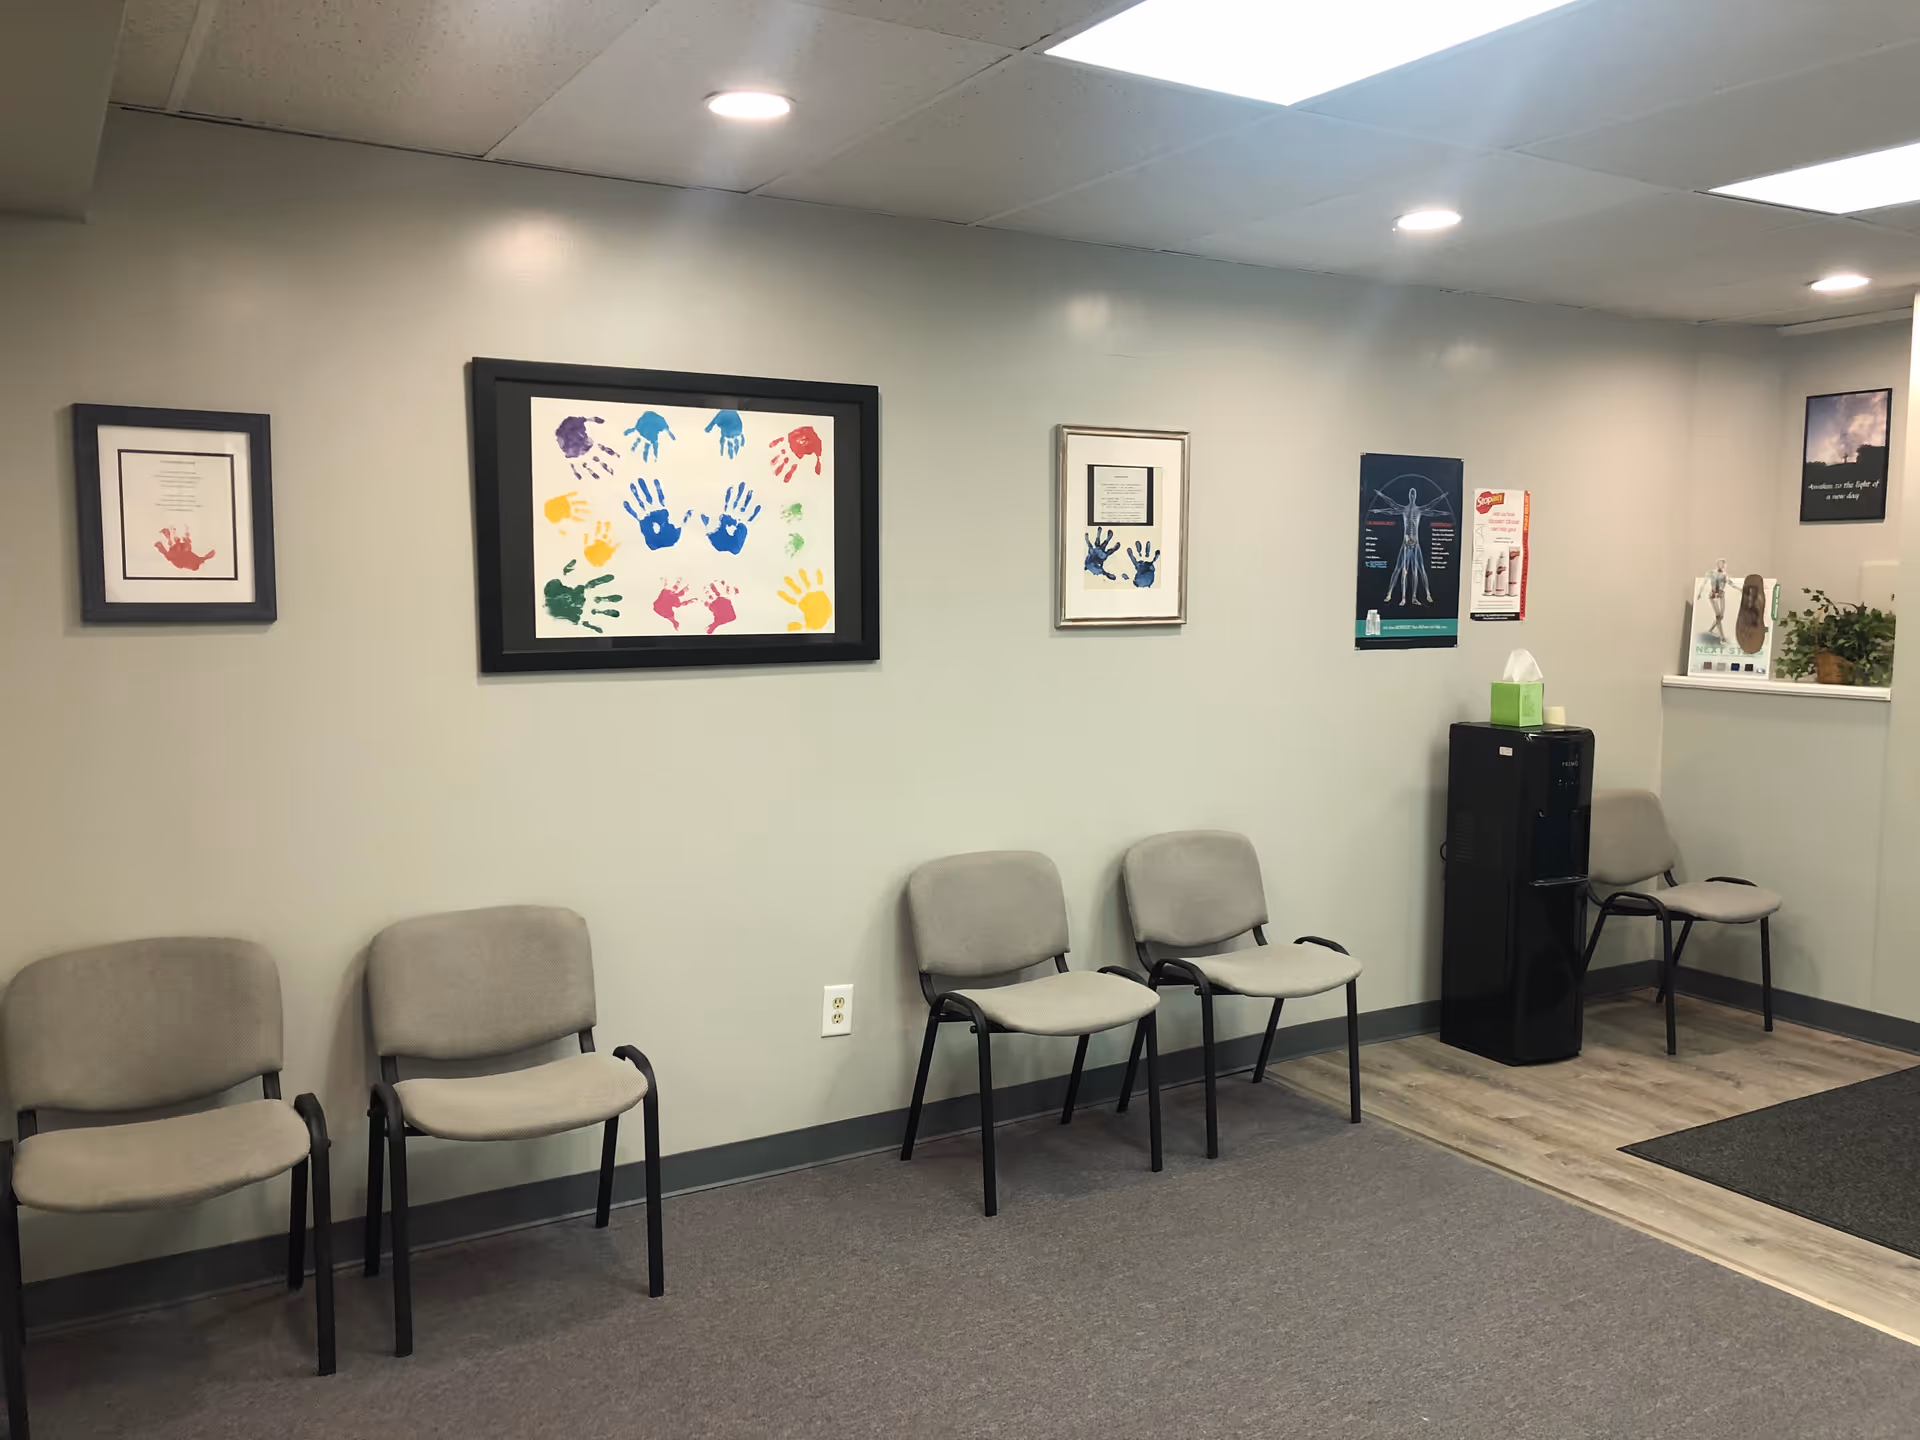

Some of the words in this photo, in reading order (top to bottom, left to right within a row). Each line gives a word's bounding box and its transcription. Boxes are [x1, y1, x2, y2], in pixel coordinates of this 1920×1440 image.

[1843, 481, 1854, 489] the
[1855, 480, 1871, 490] light
[1872, 479, 1880, 489] of
[1846, 491, 1860, 501] day
[1696, 646, 1724, 654] NEXT
